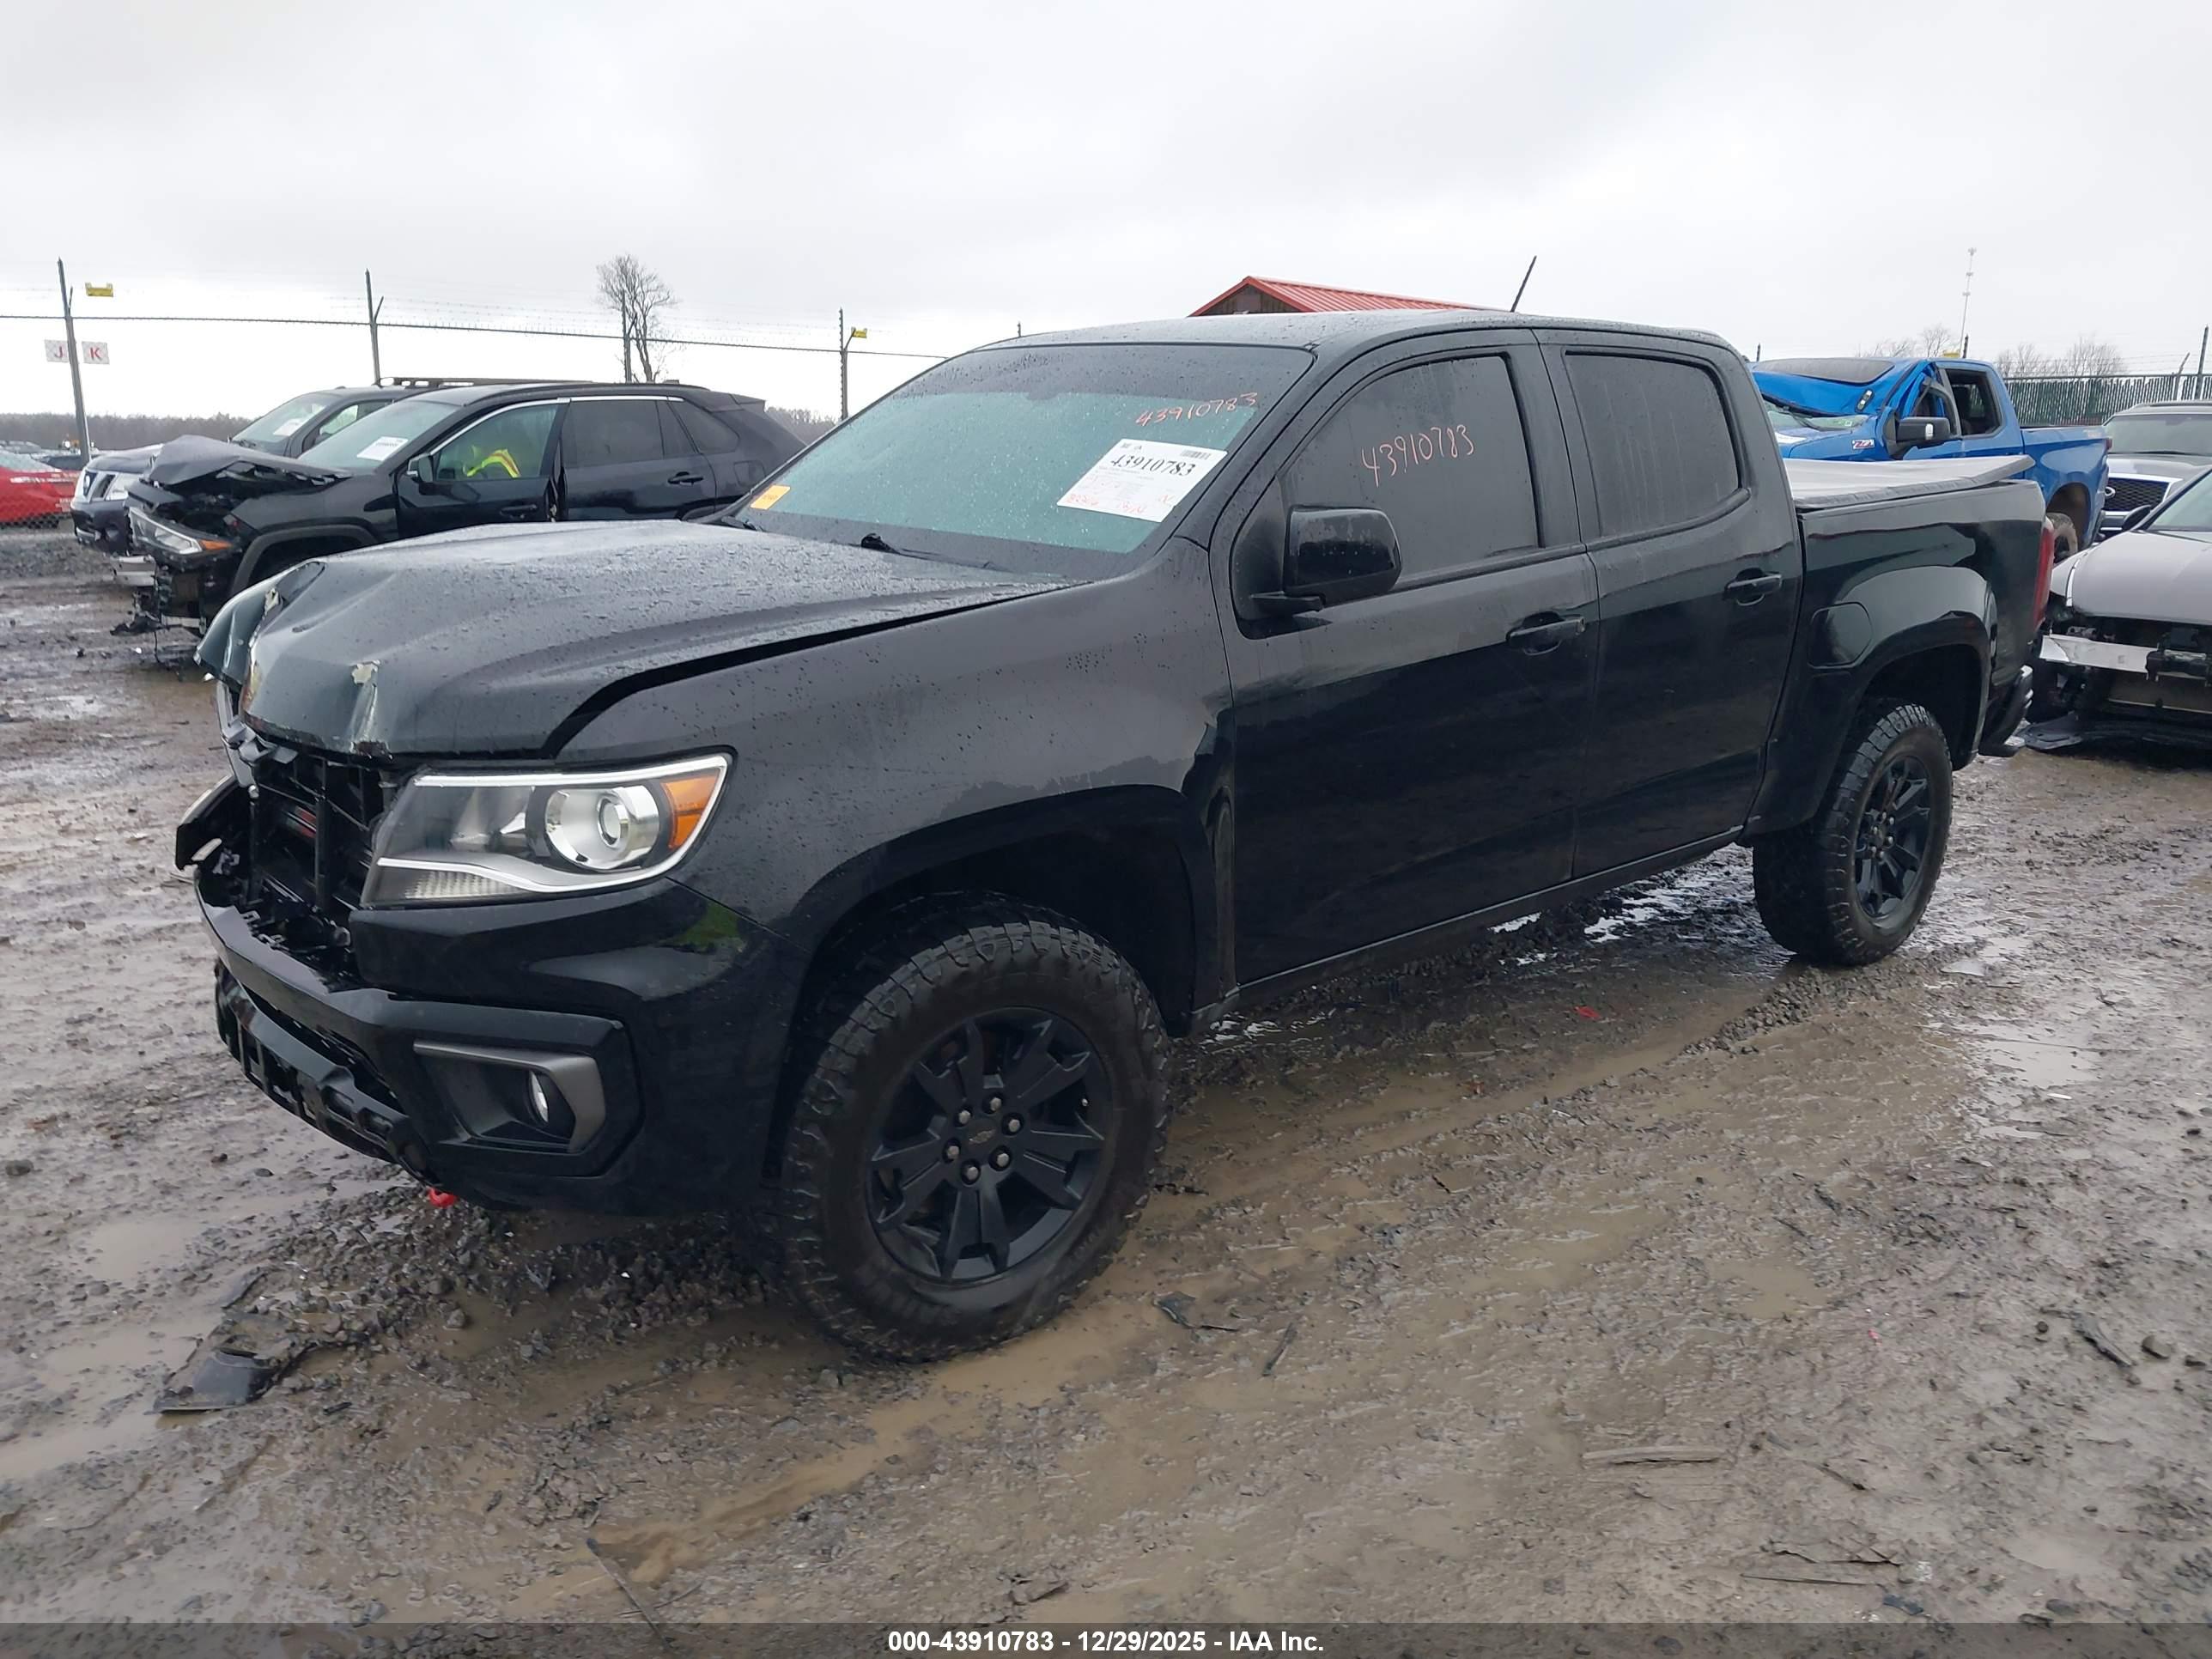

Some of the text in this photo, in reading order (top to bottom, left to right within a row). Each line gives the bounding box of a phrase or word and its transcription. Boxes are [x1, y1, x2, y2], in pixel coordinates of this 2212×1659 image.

[54, 346, 63, 358] J
[90, 347, 102, 361] K
[1135, 392, 1258, 427] 43910783
[1110, 454, 1196, 477] 43910783
[1361, 424, 1474, 488] 43910783
